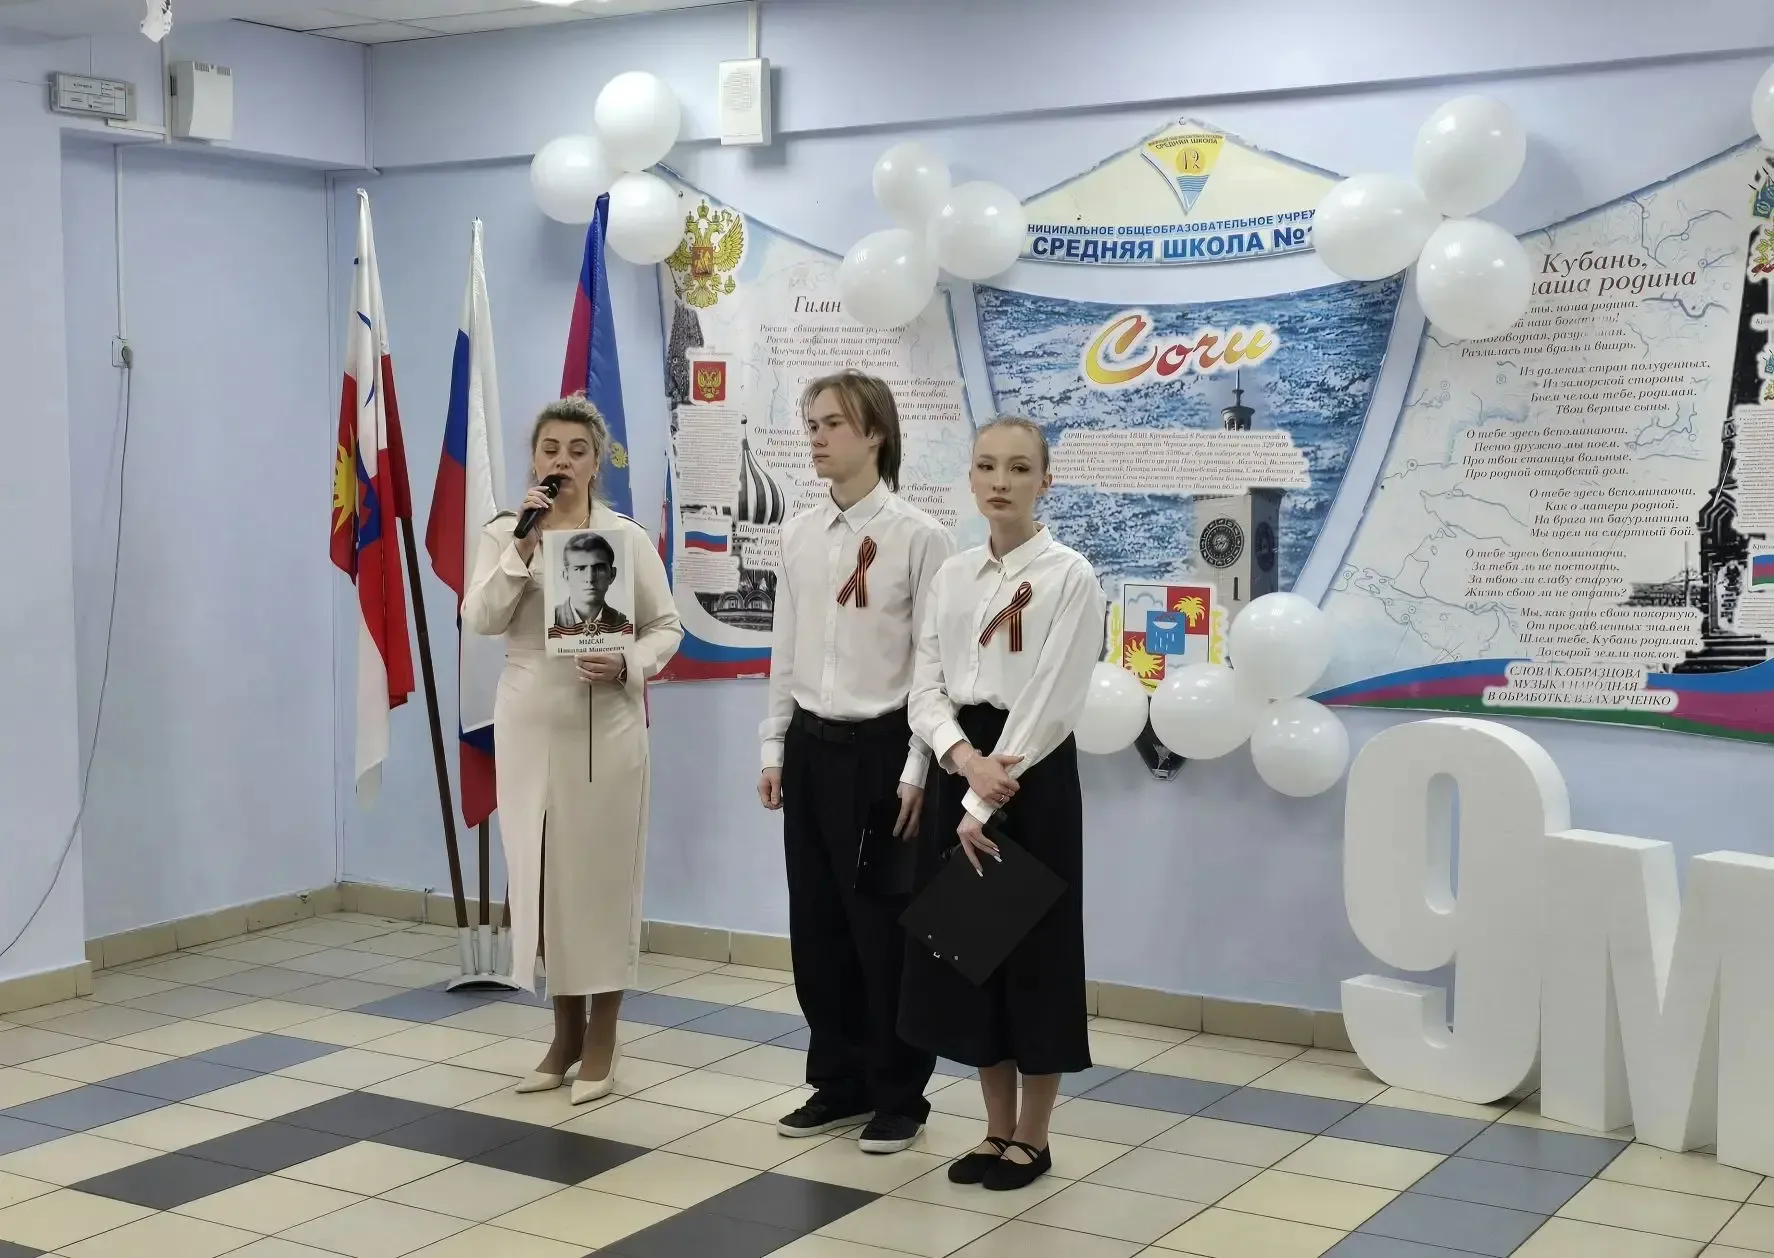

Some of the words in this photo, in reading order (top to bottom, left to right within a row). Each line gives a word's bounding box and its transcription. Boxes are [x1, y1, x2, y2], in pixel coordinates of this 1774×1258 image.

[1027, 224, 1114, 235] НИЦИПАЛЬНОЕ
[1118, 215, 1273, 236] ОБЩЕОБРАЗОВАТЕЛЬНОЕ
[1032, 237, 1154, 262] СРЕДНЯЯ
[1164, 232, 1264, 258] ШКОЛА
[1540, 251, 1648, 277] Кубань,
[1598, 271, 1696, 296] родина
[794, 296, 841, 313] Гимн
[1085, 314, 1272, 385] Сочи
[1546, 343, 1580, 355] вдаль
[1520, 366, 1535, 376] Из
[1537, 366, 1584, 377] далеких
[1589, 364, 1627, 375] стран
[1561, 375, 1624, 388] заморской
[1628, 375, 1684, 386] стороны
[1556, 405, 1583, 415] Твои
[1587, 403, 1631, 415] верные
[1466, 429, 1475, 439] О
[1478, 429, 1506, 438] тебе
[1510, 429, 1540, 439] здесь
[1474, 442, 1511, 452] Песню
[1513, 442, 1561, 453] дружно
[1564, 441, 1583, 449] мы
[1463, 455, 1484, 466] Про
[1487, 455, 1517, 464] твои
[1521, 454, 1574, 465] станицы
[1465, 469, 1487, 480] Про
[1490, 467, 1531, 479] родной
[1534, 465, 1599, 478] отцовский
[1529, 489, 1538, 497] О
[1541, 488, 1570, 497] тебе
[1574, 489, 1605, 499] здесь
[1545, 502, 1568, 511] Как
[1580, 504, 1628, 512] матери
[1534, 515, 1551, 524] На
[1553, 515, 1585, 526] врага
[1607, 514, 1689, 525] басурманина
[1530, 529, 1548, 537] Мы
[1552, 530, 1580, 539] идем
[1585, 529, 1598, 537] на
[1602, 527, 1666, 538] смертный
[1465, 549, 1474, 557] О
[1477, 549, 1505, 557] тебе
[1508, 551, 1539, 559] здесь
[1472, 562, 1486, 570] За
[1489, 562, 1519, 570] тебя
[1468, 575, 1482, 584] За
[1485, 575, 1518, 584] твою
[1538, 575, 1572, 586] славу
[1575, 577, 1623, 586] старую
[1464, 587, 1503, 597] Жизнь
[1506, 587, 1535, 597] свою
[1572, 589, 1627, 599] отдать?
[1569, 610, 1597, 619] дань
[1601, 608, 1630, 617] свою
[1526, 621, 1545, 630] От
[1548, 621, 1642, 632] прославленных
[1520, 633, 1553, 643] Шлем
[1592, 635, 1637, 646] Кубань
[1536, 647, 1551, 657] До
[1555, 649, 1590, 659] сырой
[1510, 666, 1551, 676] СЛОВА
[1488, 692, 1496, 700] В
[1498, 692, 1572, 703] ОБРАБОТКЕ
[1341, 716, 1571, 1105] 9
